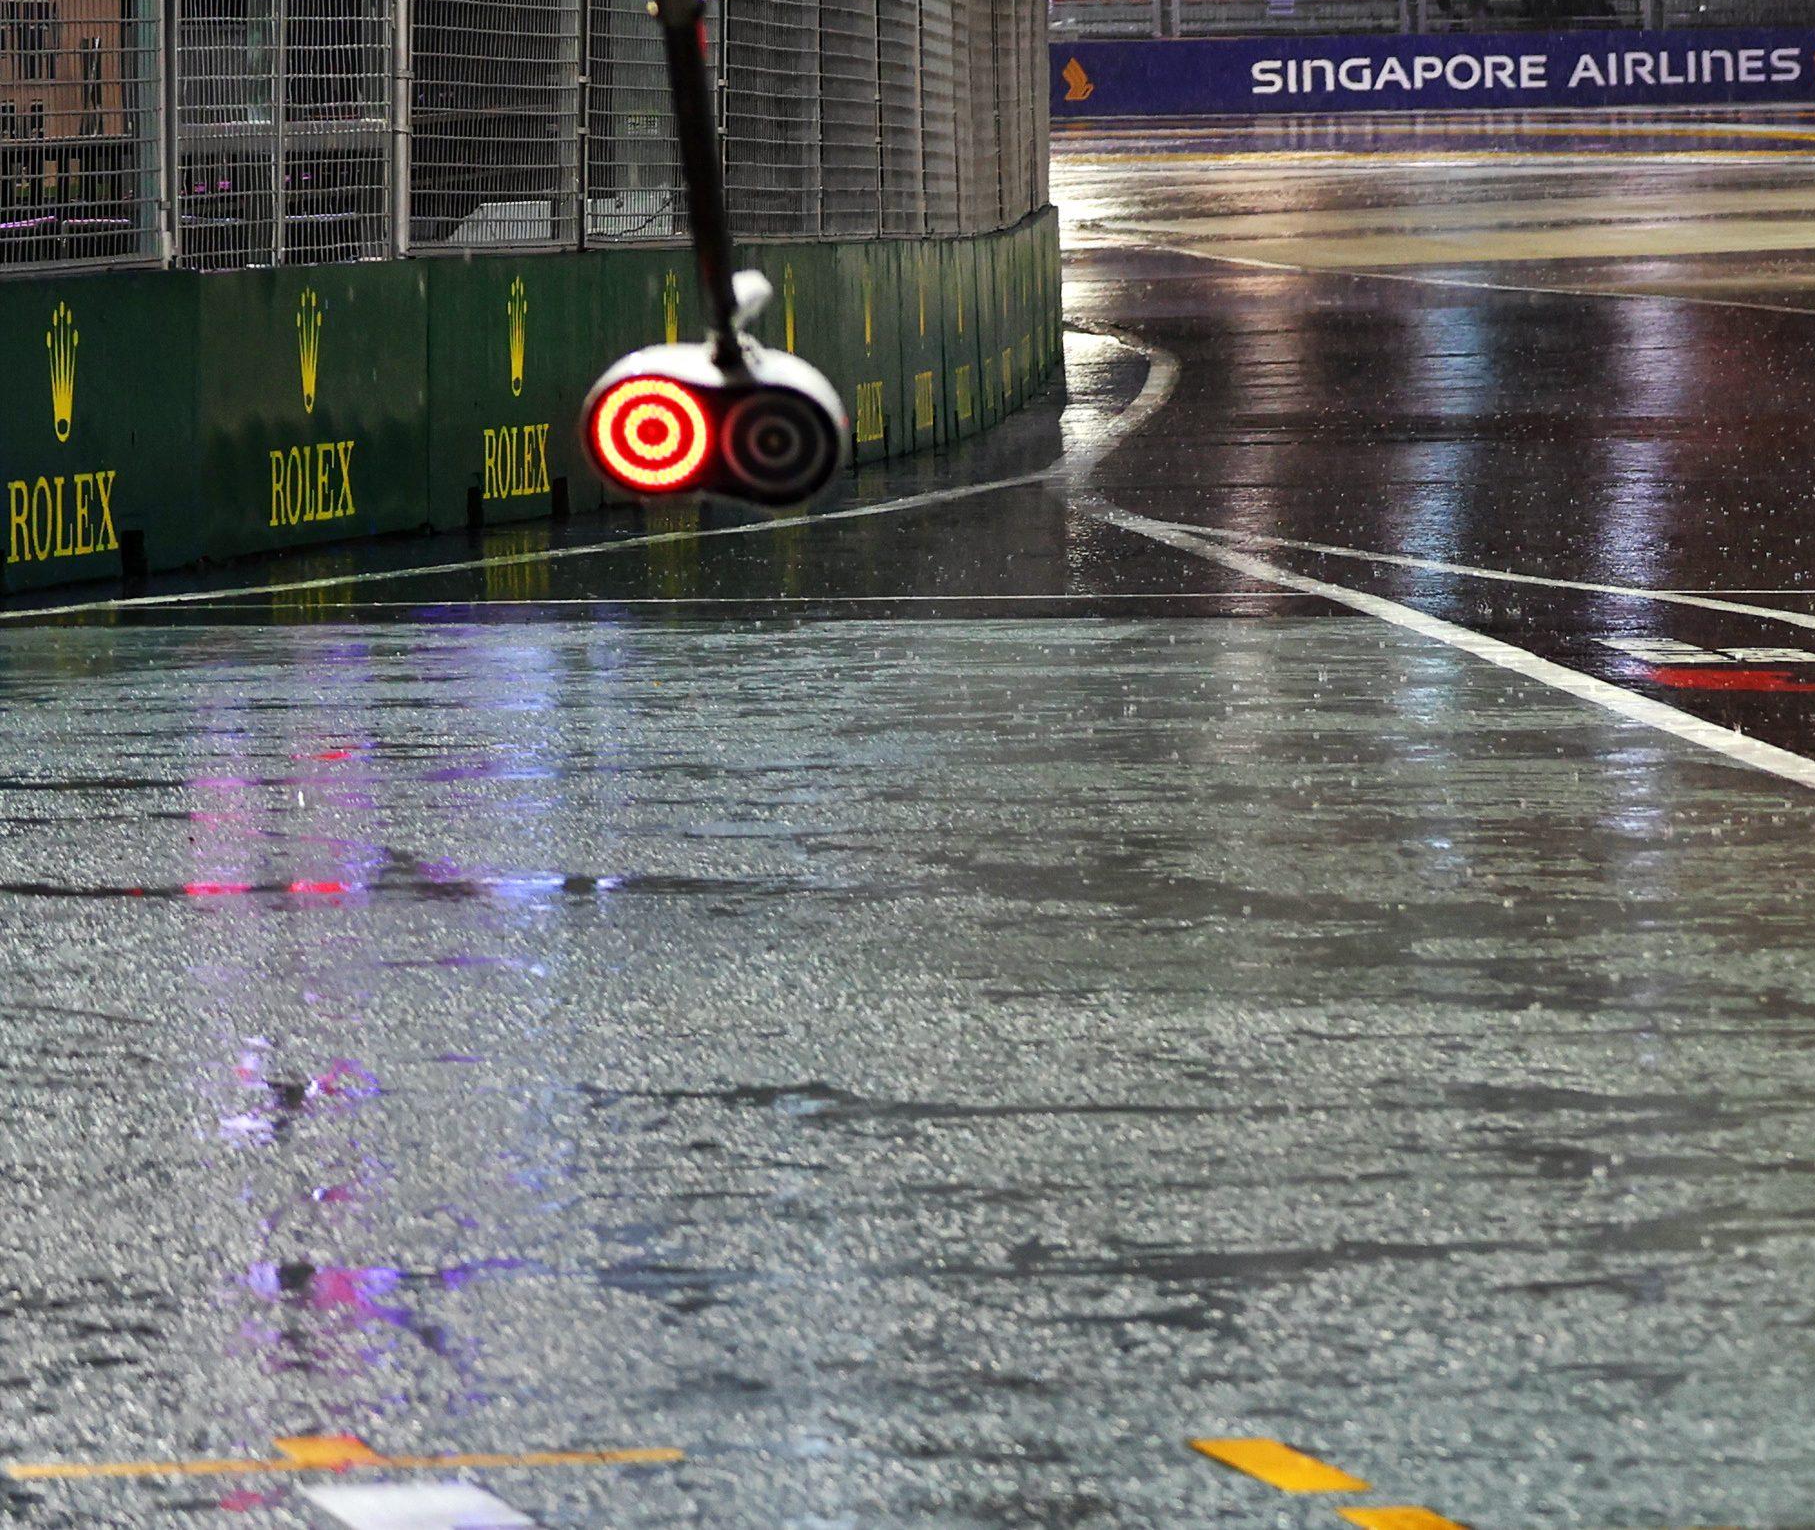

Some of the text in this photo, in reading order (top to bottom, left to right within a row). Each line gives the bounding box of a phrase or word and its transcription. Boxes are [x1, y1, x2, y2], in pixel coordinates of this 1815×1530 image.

[1250, 46, 1801, 95] SINGAPORE AIRLINES
[269, 440, 356, 527] ROLEX
[483, 423, 551, 500] ROLEX
[7, 470, 119, 563] ROLEX
